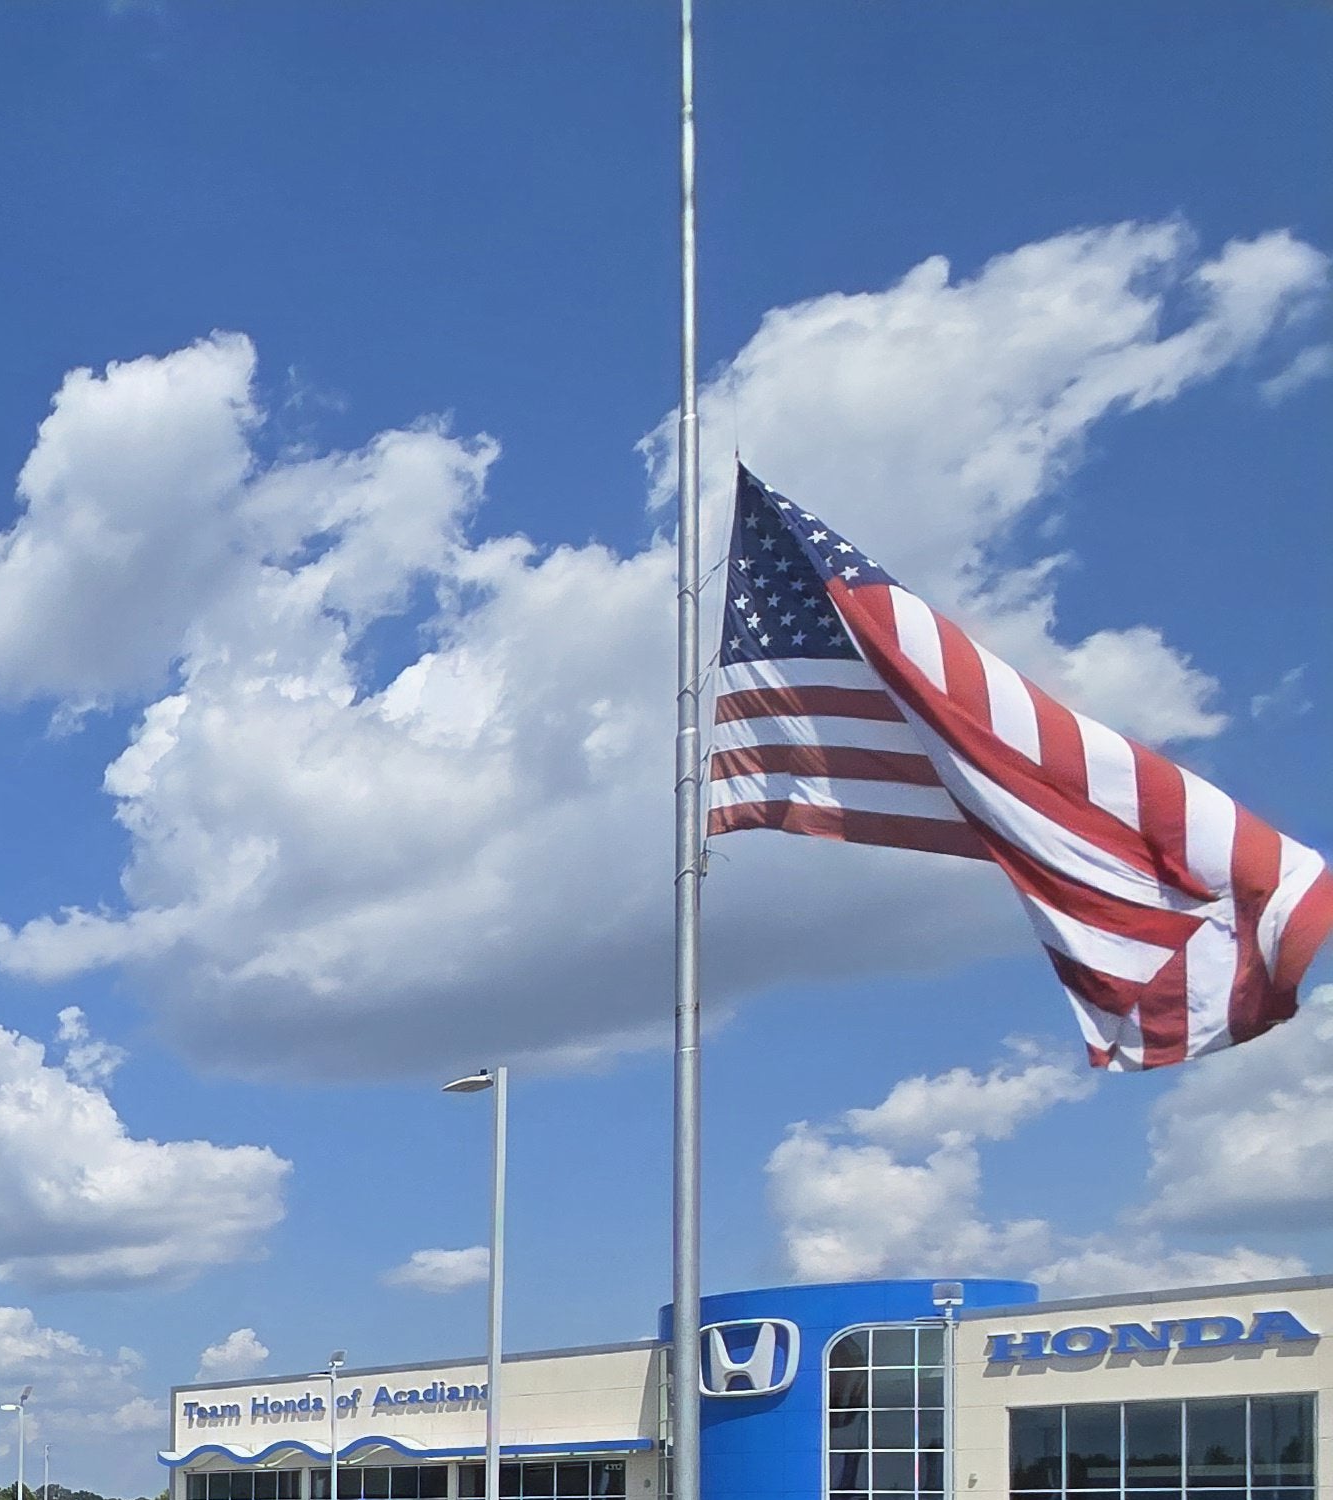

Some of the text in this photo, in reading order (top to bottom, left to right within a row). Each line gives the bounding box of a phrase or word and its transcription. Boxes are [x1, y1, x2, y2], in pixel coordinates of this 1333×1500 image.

[986, 1310, 1321, 1364] HONDA
[183, 1401, 241, 1420] Team
[251, 1392, 325, 1416] Honda
[336, 1388, 363, 1409] of
